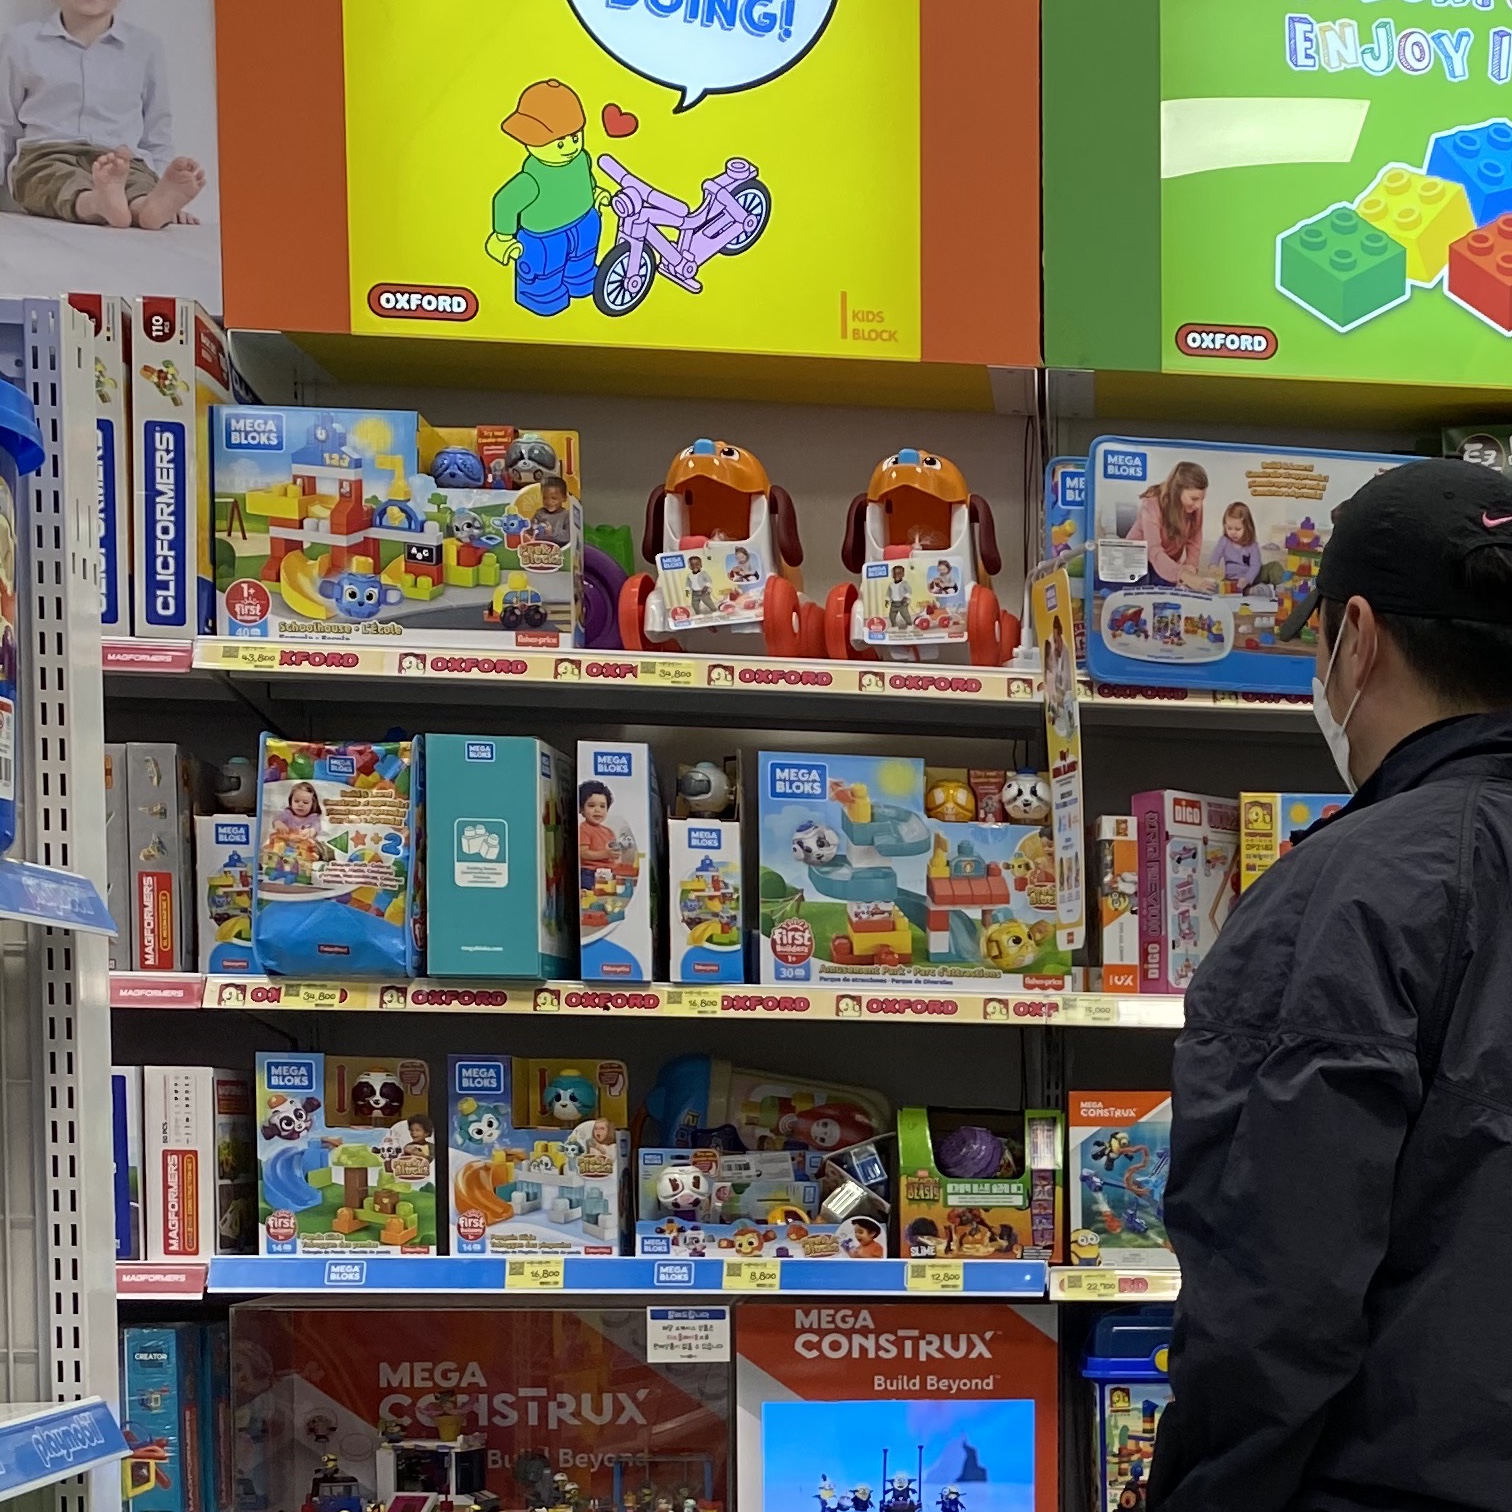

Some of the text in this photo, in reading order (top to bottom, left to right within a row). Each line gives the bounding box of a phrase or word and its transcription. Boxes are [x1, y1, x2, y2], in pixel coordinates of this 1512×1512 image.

[1286, 14, 1474, 81] ENJOY
[380, 292, 467, 315] OXFORD
[852, 310, 884, 323] KIDS
[151, 315, 164, 337] 110
[852, 329, 898, 343] BLOCK
[1186, 332, 1268, 353] OXFORD
[231, 418, 276, 432] MEGA
[231, 432, 279, 446] BLOKS
[1107, 454, 1142, 466] MEGA
[1107, 465, 1143, 477] BLOKS
[155, 429, 176, 617] CLICFORMERS
[107, 653, 172, 663] MAGFORMERS
[430, 657, 528, 675] OXFORD
[738, 669, 833, 687] OXFORD
[889, 675, 982, 693] OXFORD
[597, 756, 628, 764] MEGA
[597, 764, 628, 773] BLOKS
[775, 769, 821, 782] MEGA
[775, 781, 821, 794] BLOKS
[144, 876, 156, 966] MAGFORMERS
[773, 930, 811, 946] first
[411, 990, 508, 1006] OXFORD
[565, 992, 660, 1009] OXFORD
[867, 998, 958, 1015] OXFORD
[271, 1065, 307, 1076] MEGA
[462, 1067, 496, 1078] MEGA
[271, 1075, 309, 1086] BLOKS
[462, 1078, 497, 1088] BLOKS
[1080, 1107, 1138, 1117] CONSTRUX
[168, 1154, 178, 1250] MAGFORMERS
[268, 1214, 295, 1228] first
[458, 1216, 486, 1228] first
[330, 1272, 361, 1280] BLOKS
[530, 1269, 560, 1279] 16,800
[660, 1266, 688, 1274] MEGA
[750, 1271, 777, 1280] 8,800
[122, 1274, 186, 1282] MAGFORMERS
[660, 1273, 689, 1281] BLOKS
[931, 1273, 960, 1282] 12,800
[795, 1309, 875, 1330] MEGA
[795, 1329, 994, 1361] CONSTRUX
[135, 1353, 168, 1361] CREATOR
[379, 1362, 488, 1388] MEGA
[873, 1375, 994, 1393] Build Beyond
